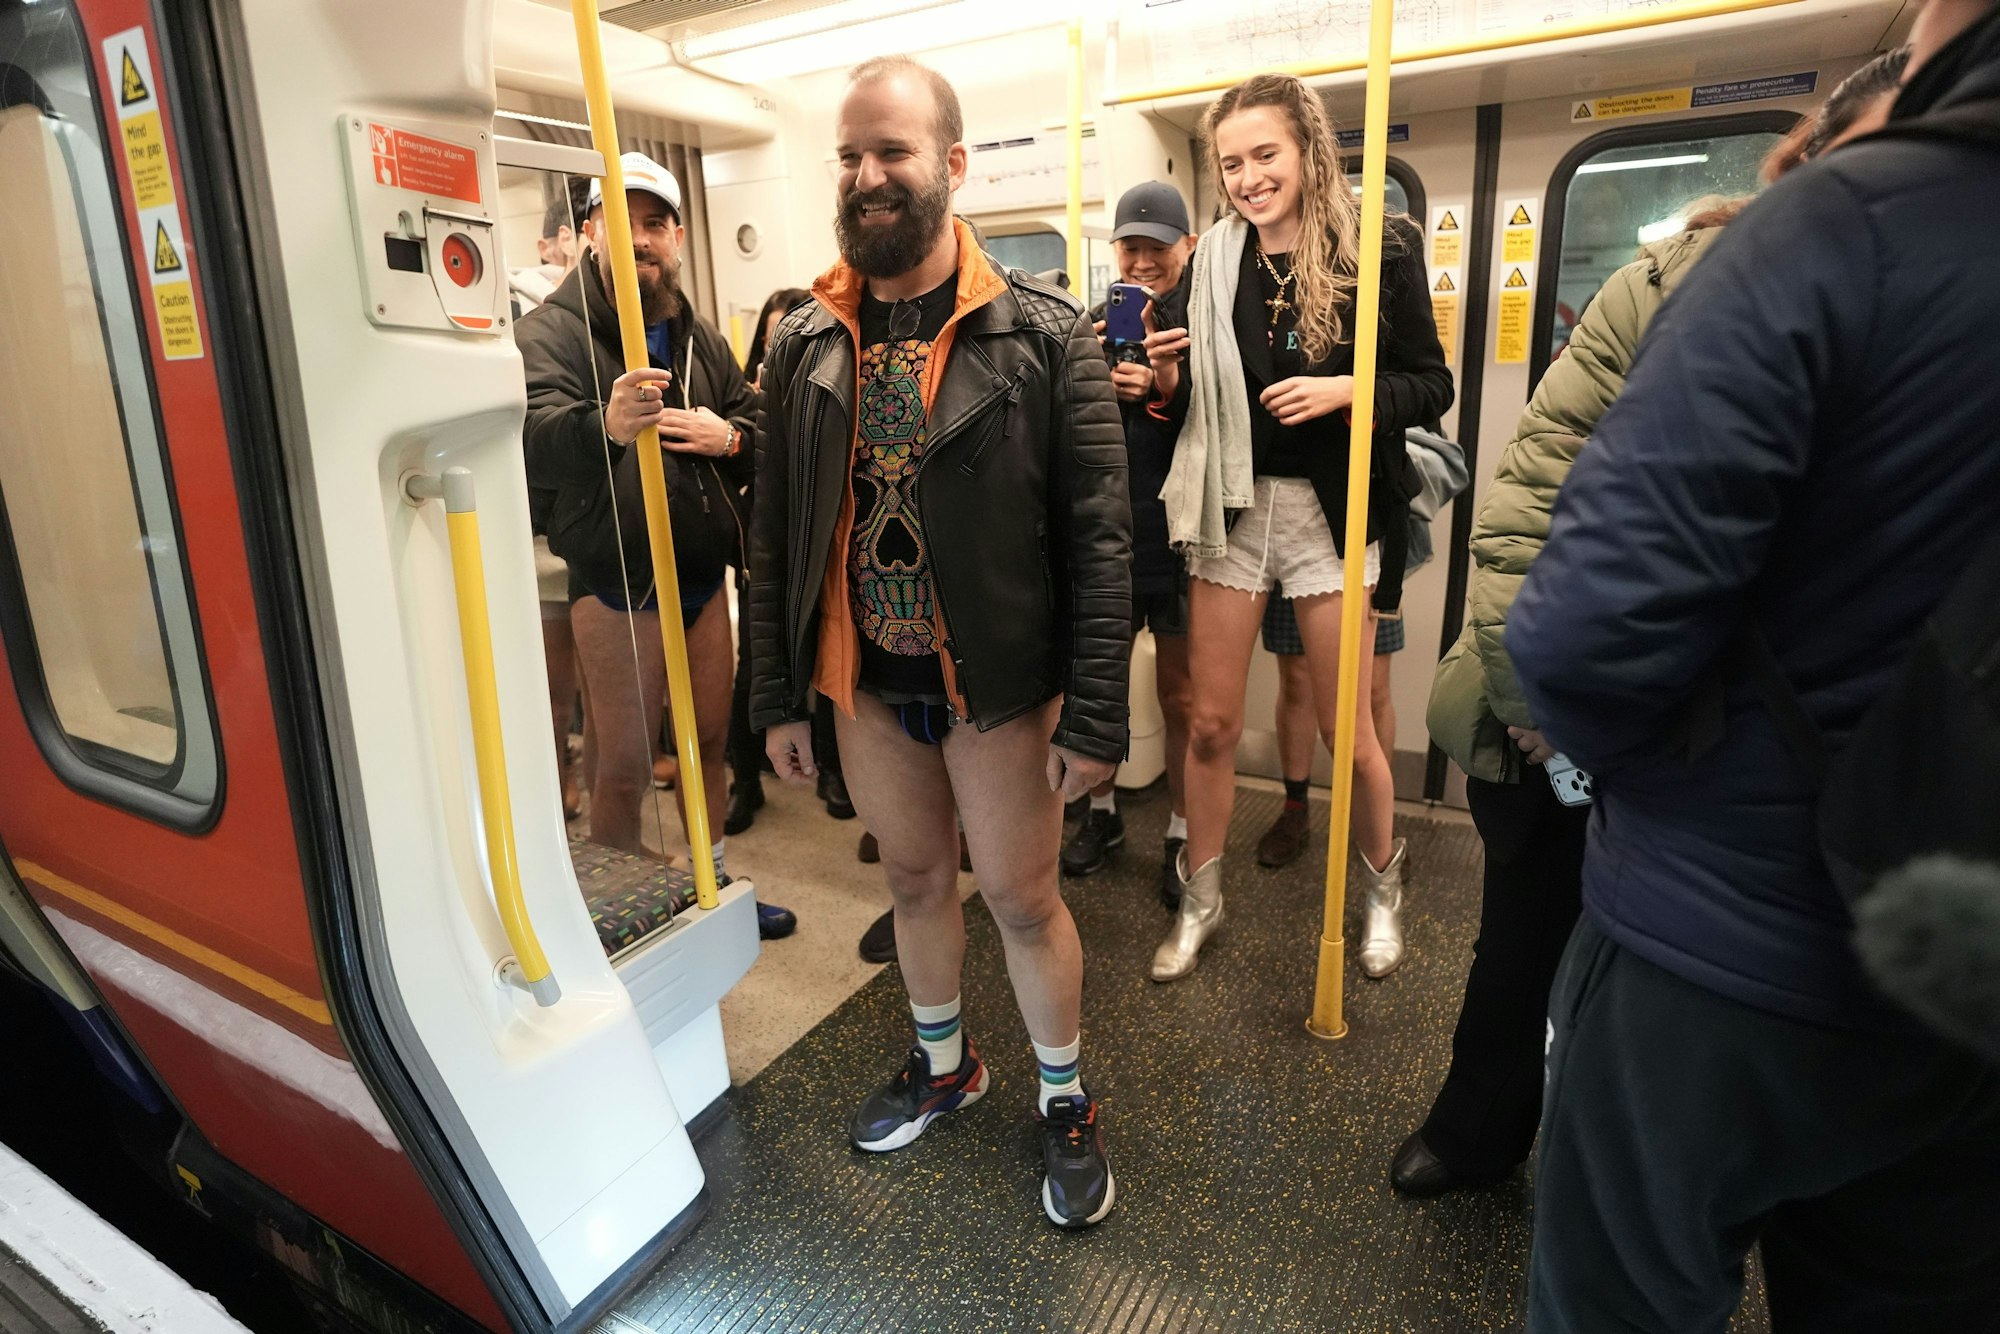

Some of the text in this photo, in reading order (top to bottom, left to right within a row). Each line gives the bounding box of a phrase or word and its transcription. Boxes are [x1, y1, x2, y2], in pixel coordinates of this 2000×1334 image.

[1750, 77, 1794, 90] prosecution
[127, 124, 147, 139] Mind
[131, 143, 161, 160] the gap
[398, 136, 465, 161] Emergency alarm
[160, 294, 190, 308] Caution
